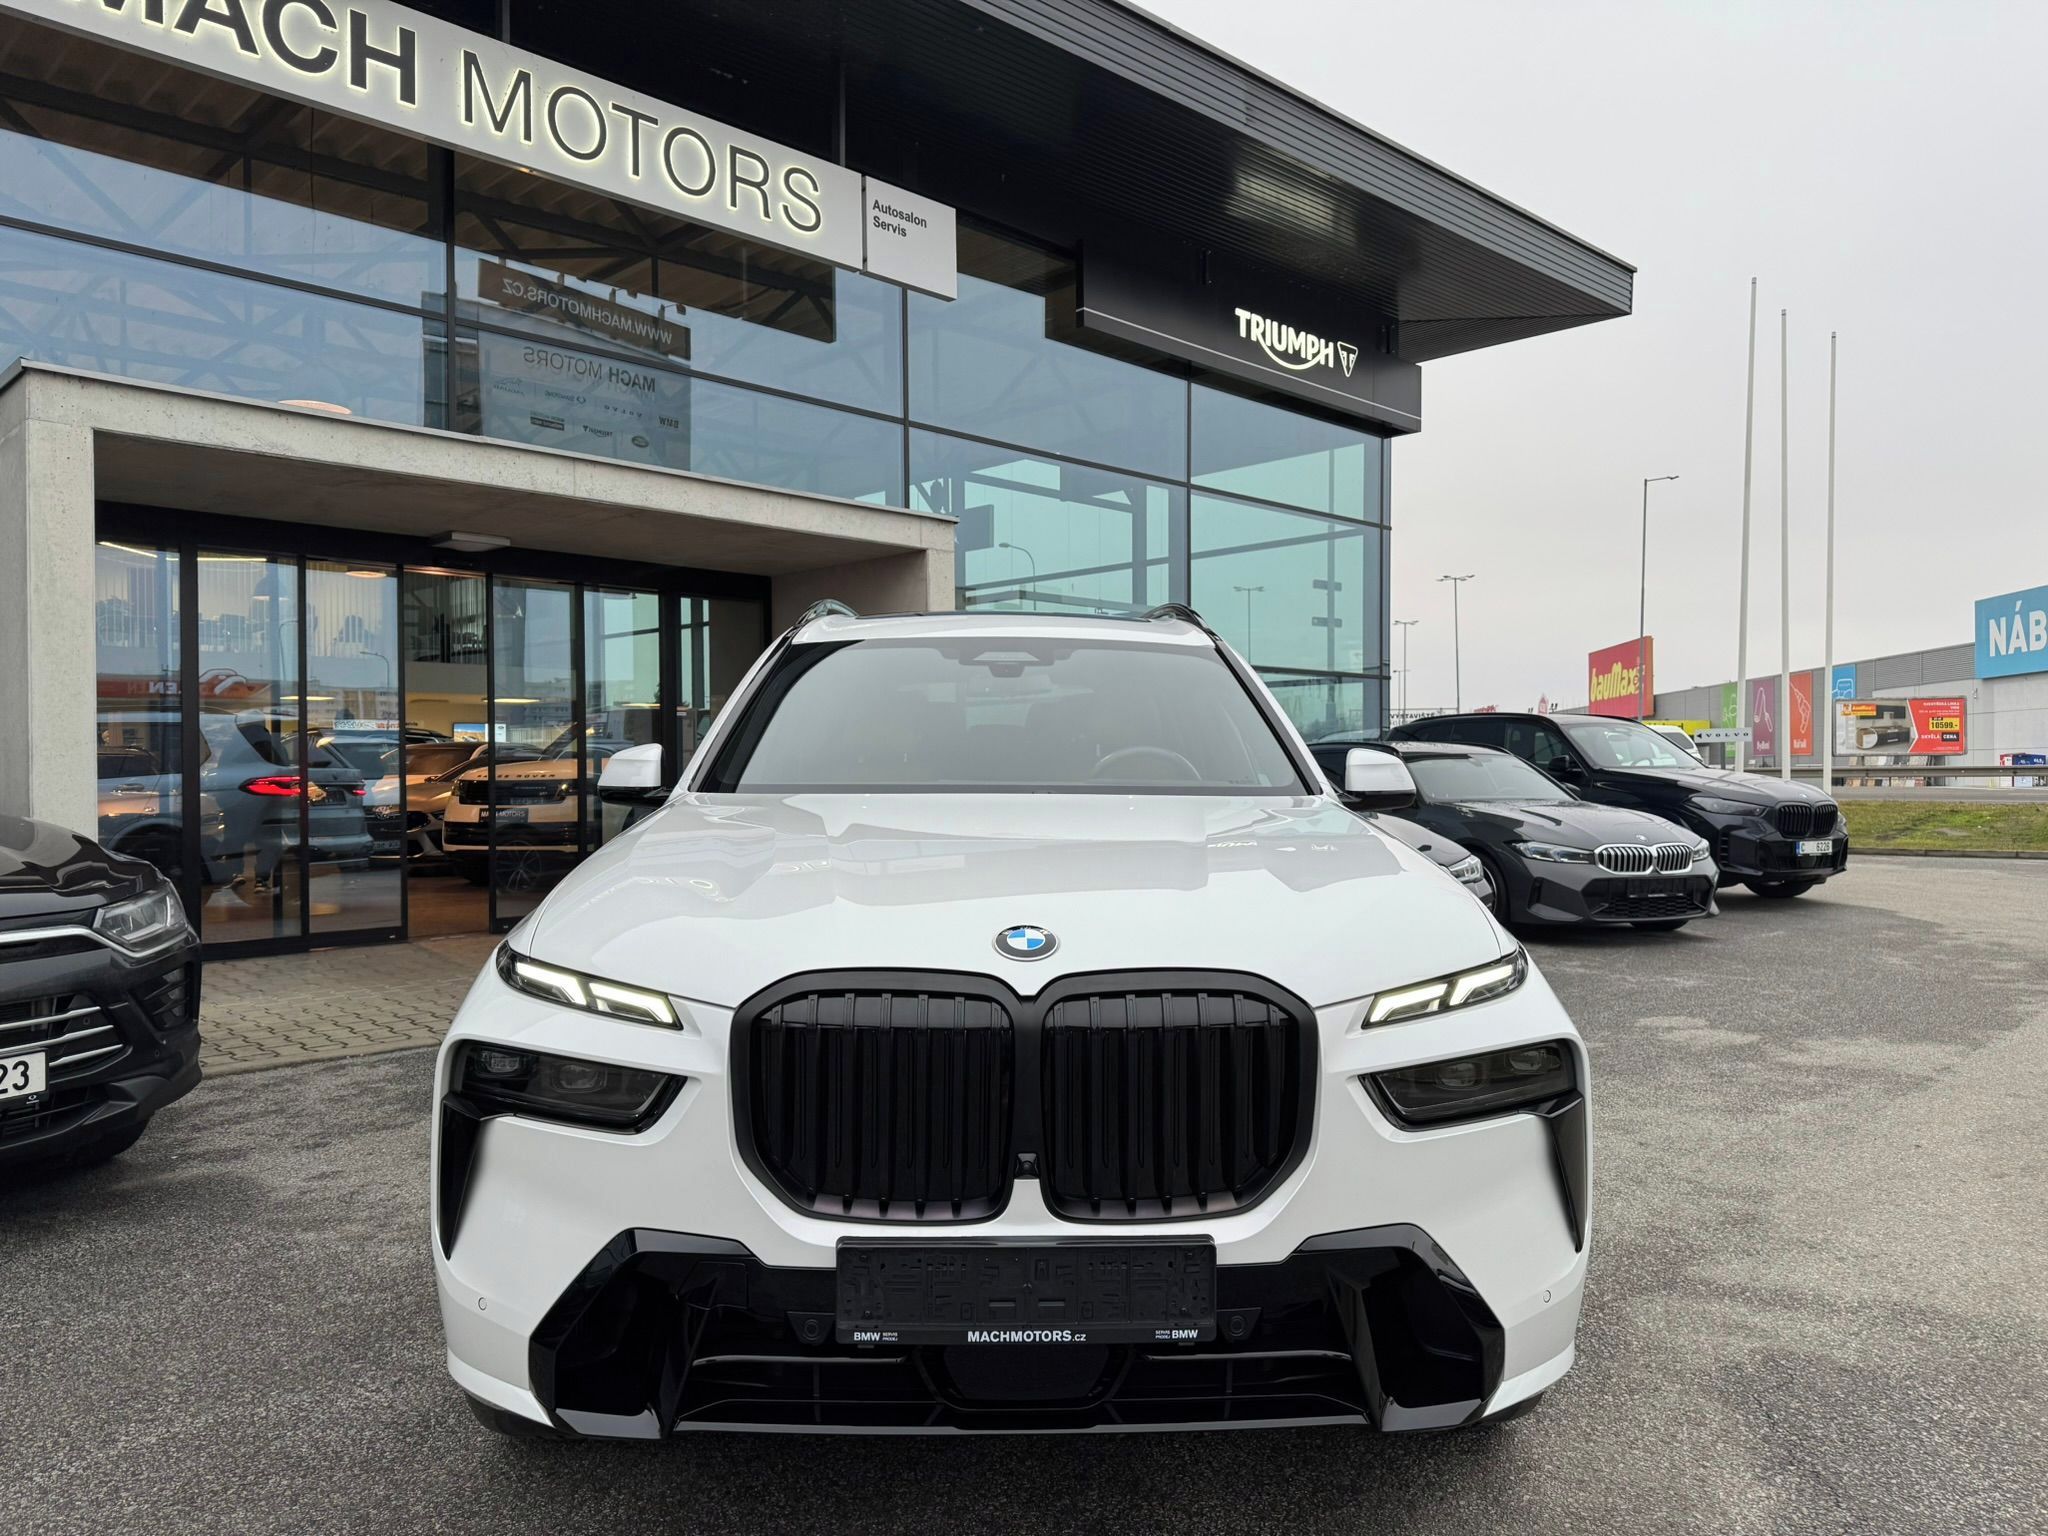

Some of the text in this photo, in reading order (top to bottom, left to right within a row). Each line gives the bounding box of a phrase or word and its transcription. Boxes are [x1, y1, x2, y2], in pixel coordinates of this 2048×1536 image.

[461, 48, 822, 233] MOTORS
[872, 199, 928, 229] Autosalon
[872, 215, 908, 238] Servis
[1234, 307, 1334, 370] TRIUMPH
[1988, 599, 2048, 657] NÁB
[853, 1331, 881, 1342] BMW
[967, 1330, 1087, 1343] MACHMOTORS.cz
[1171, 1329, 1199, 1340] BMW
